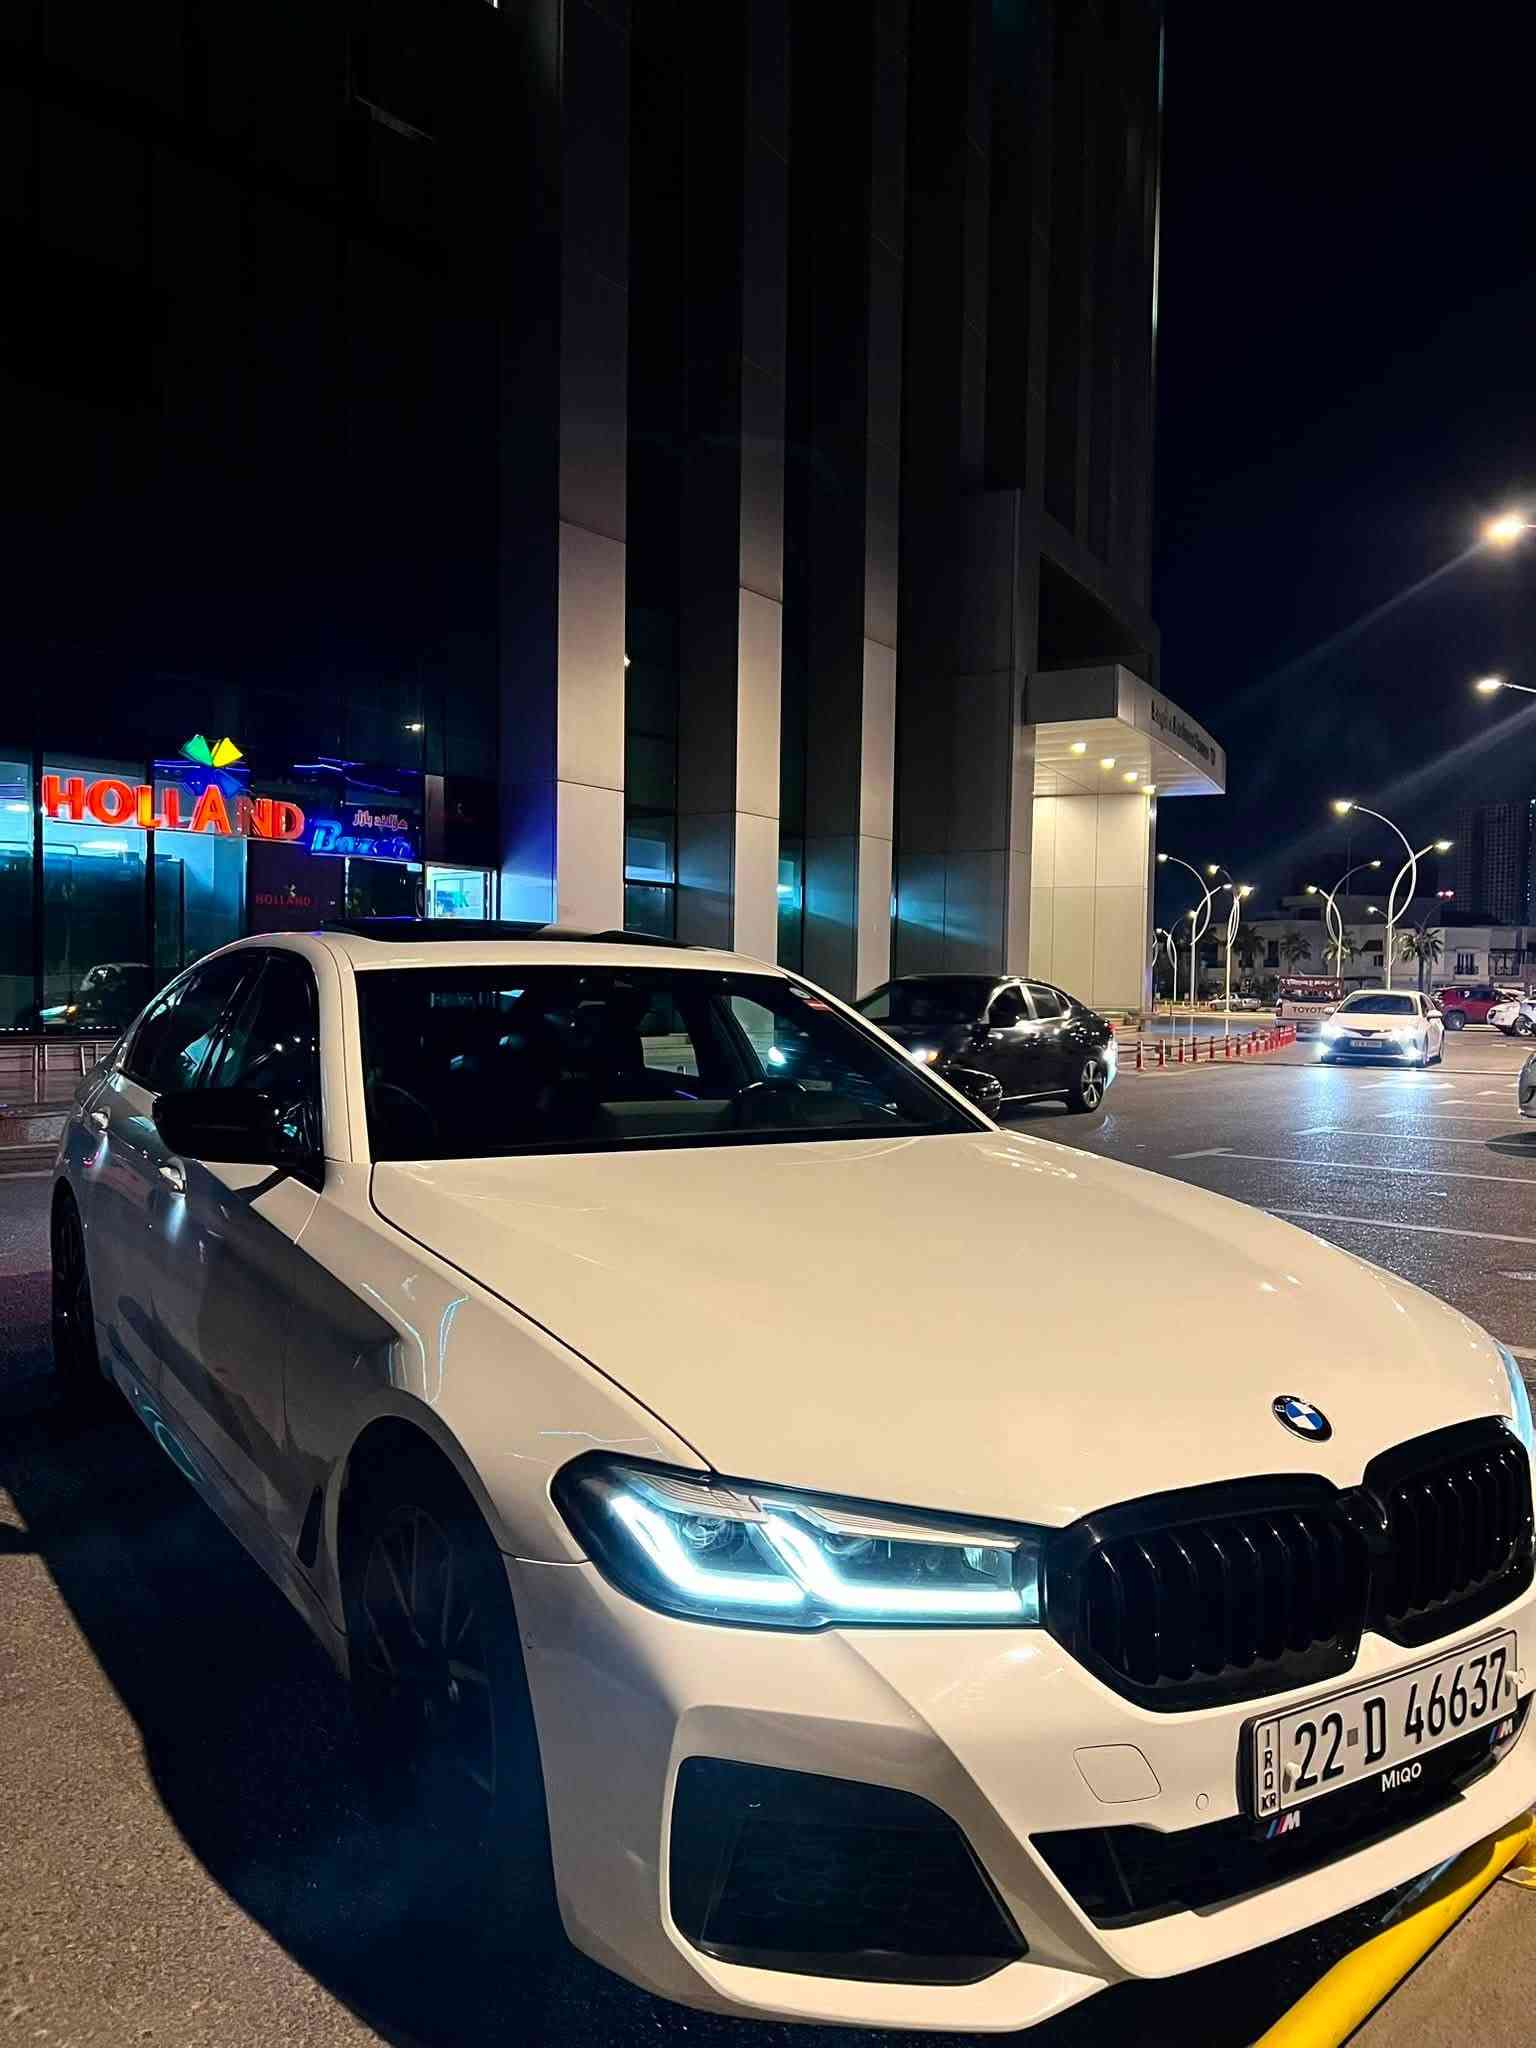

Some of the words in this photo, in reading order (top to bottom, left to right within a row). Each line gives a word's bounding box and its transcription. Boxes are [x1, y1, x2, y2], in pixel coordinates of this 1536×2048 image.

[42, 775, 305, 840] HOLLAND
[1292, 1006, 1325, 1014] TOYOT
[1294, 1712, 1345, 1792] 22
[1364, 1696, 1386, 1765] D
[1404, 1646, 1507, 1745] 46637
[1261, 1792, 1276, 1810] KR
